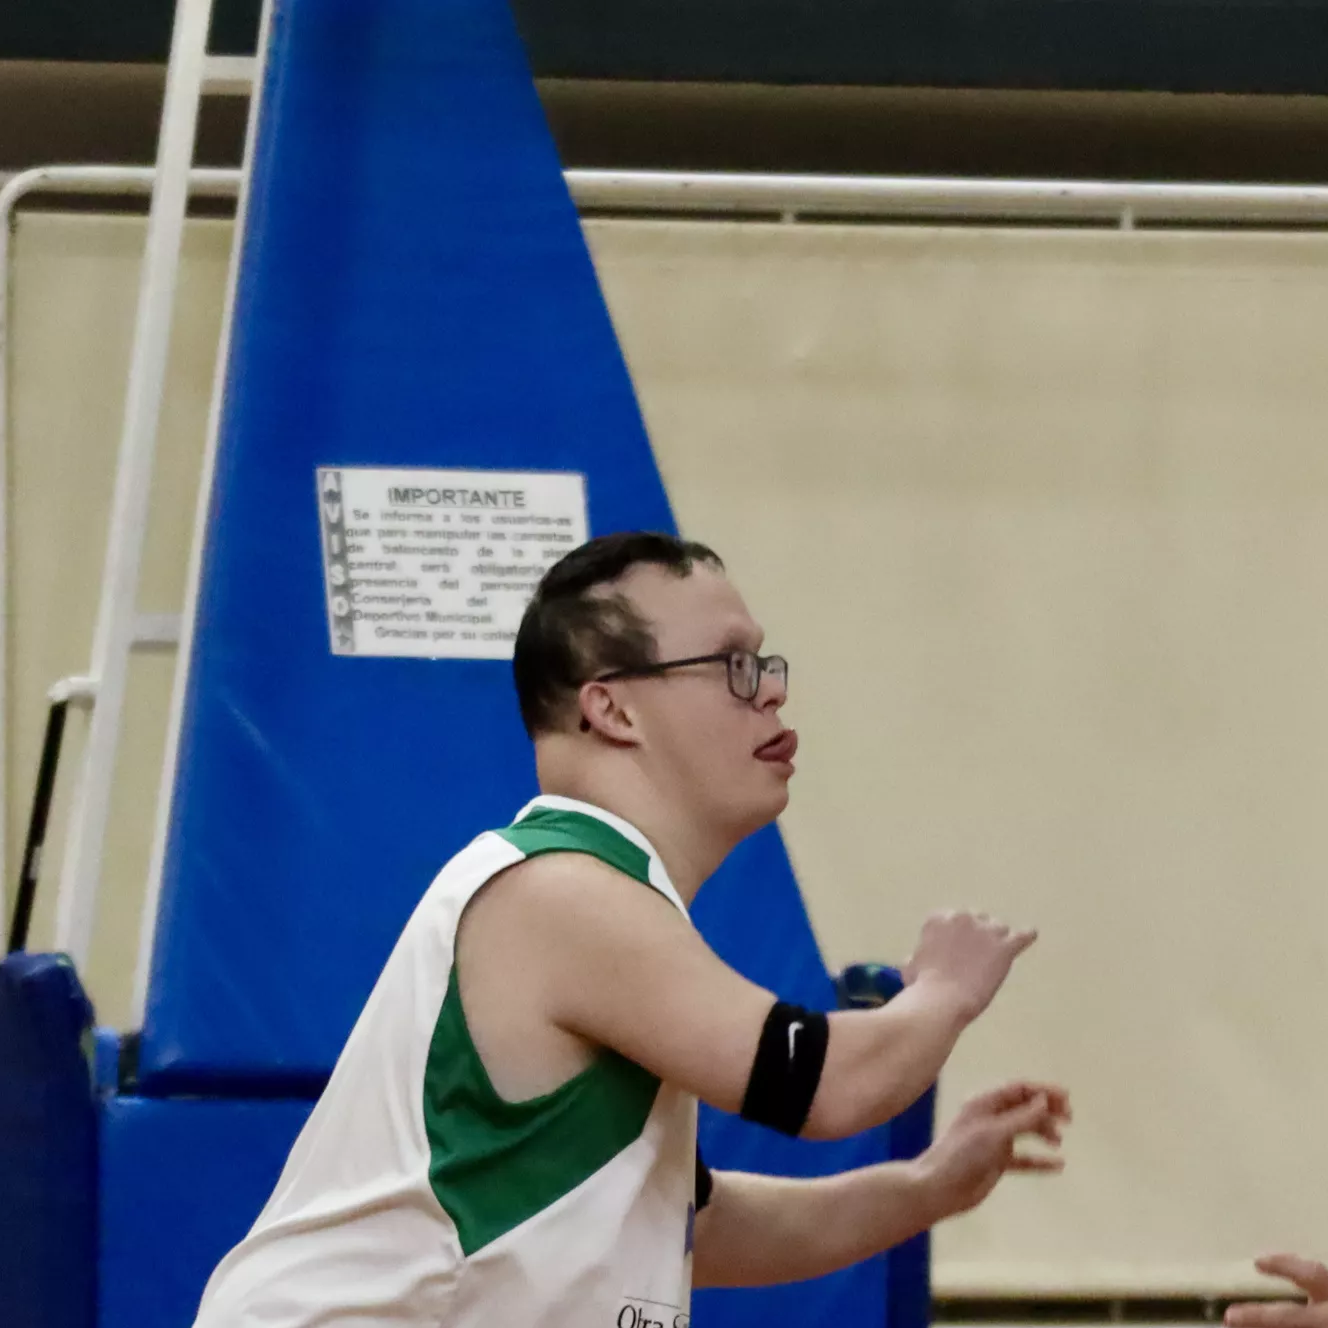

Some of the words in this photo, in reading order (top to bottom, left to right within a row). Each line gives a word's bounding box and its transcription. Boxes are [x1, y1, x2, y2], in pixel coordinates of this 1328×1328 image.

[387, 487, 525, 507] IMPORTANTE
[352, 509, 370, 521] Se
[380, 511, 433, 522] informa
[461, 513, 480, 524] los
[346, 528, 371, 539] que
[477, 546, 493, 558] de
